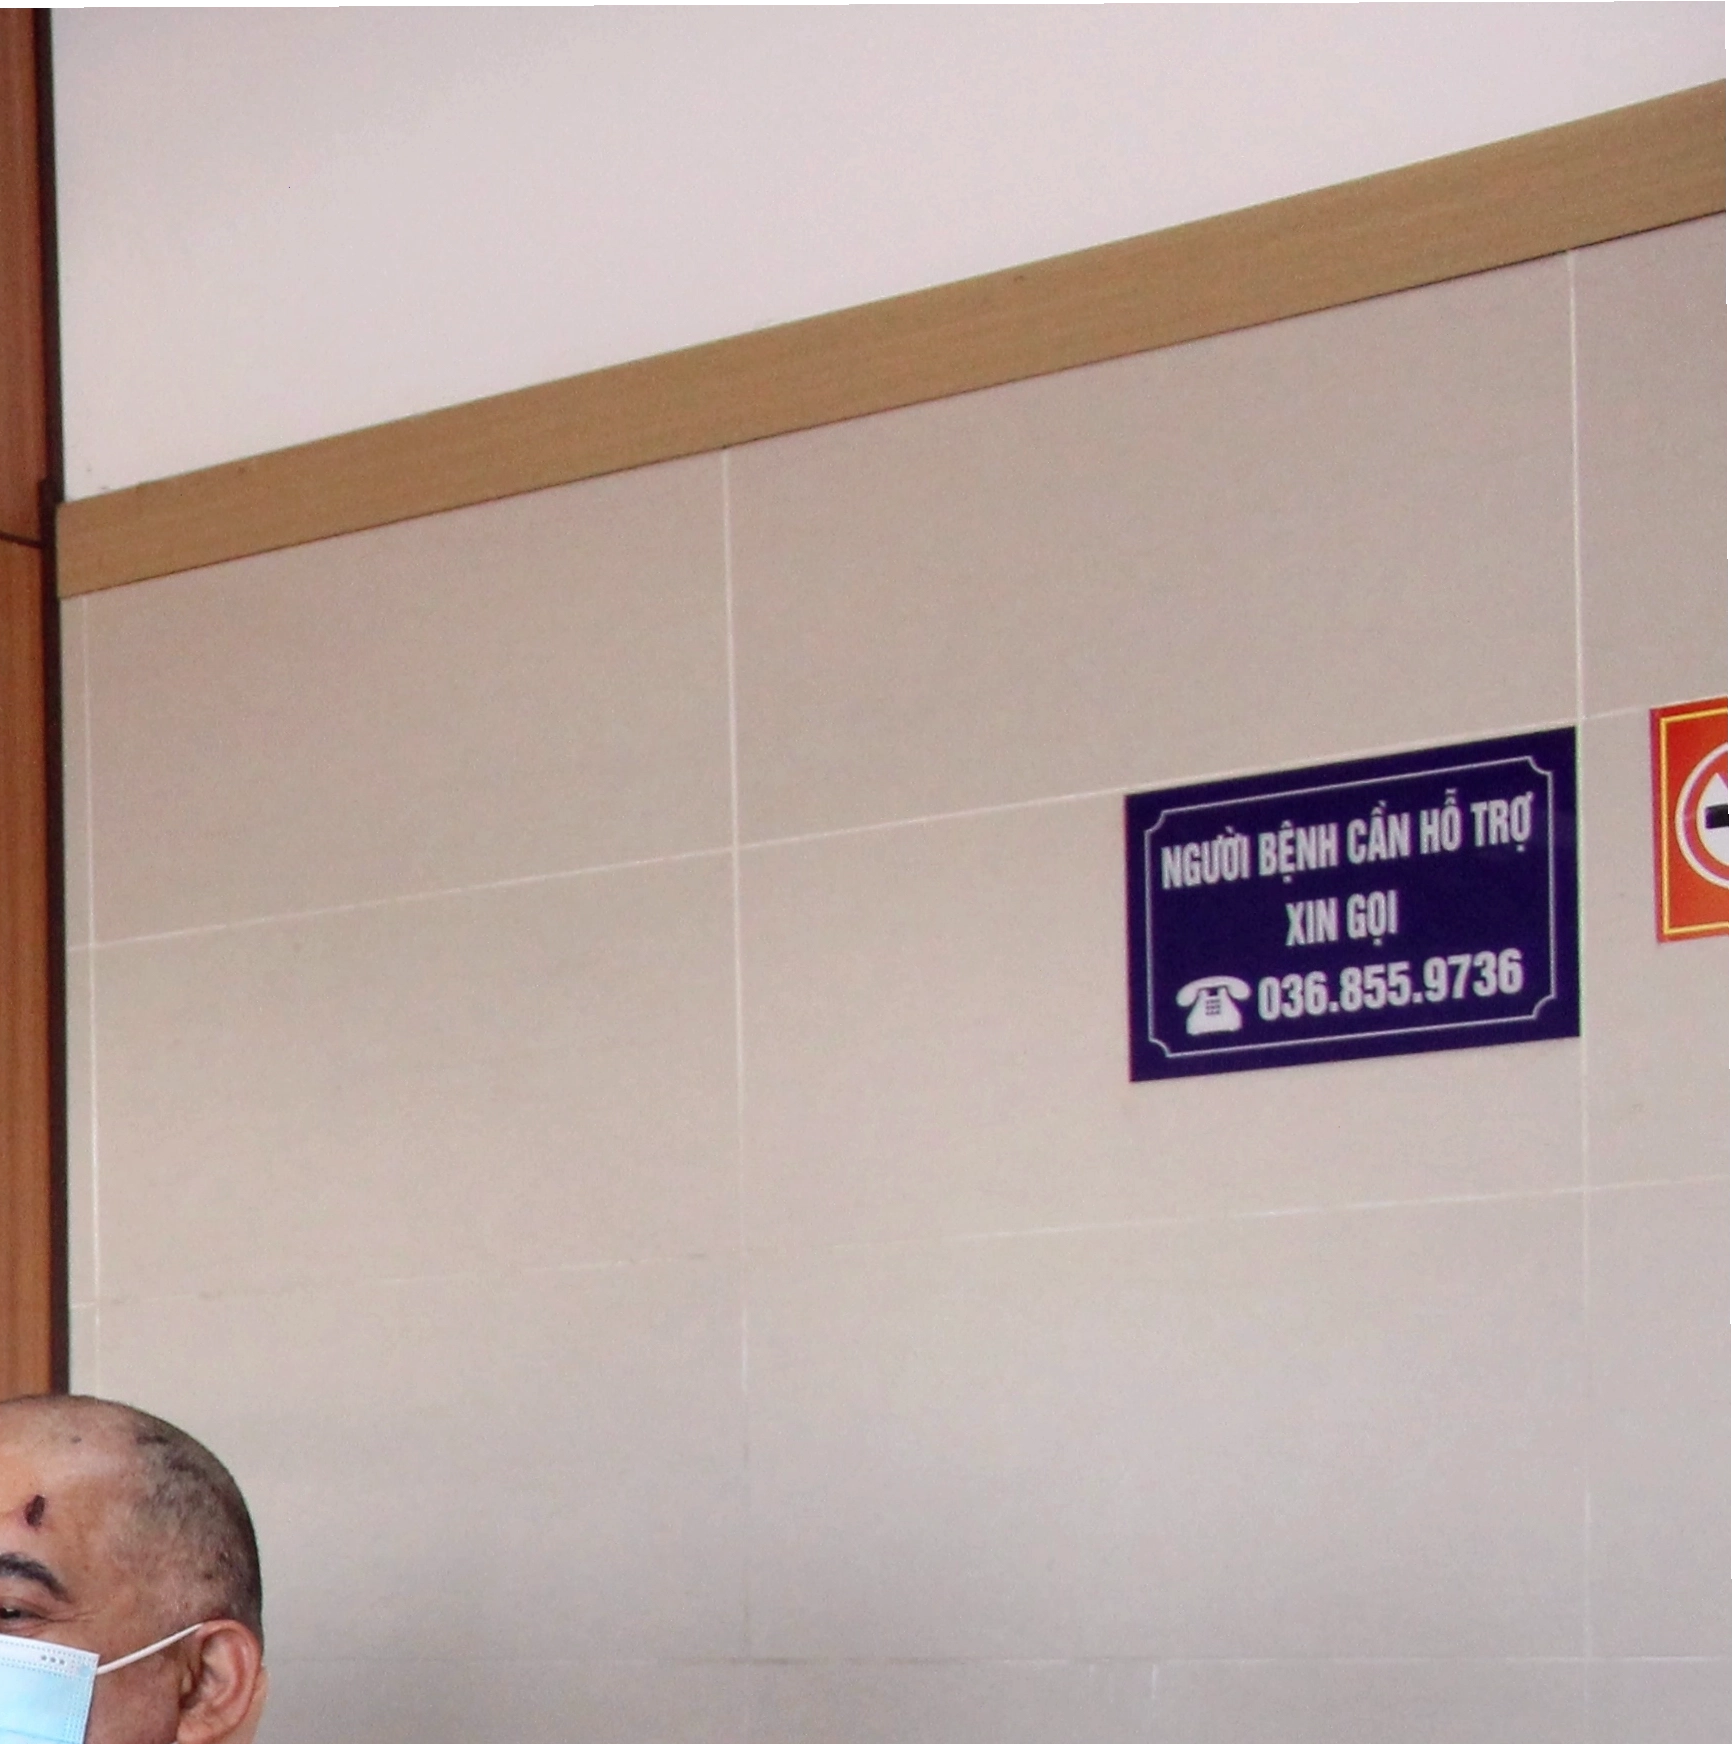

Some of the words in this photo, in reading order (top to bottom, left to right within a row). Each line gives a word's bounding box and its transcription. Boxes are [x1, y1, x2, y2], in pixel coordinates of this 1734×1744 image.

[1161, 825, 1250, 889] NGƯỜI
[1258, 819, 1339, 884] BỆNH
[1346, 800, 1411, 865] CẦN
[1419, 788, 1463, 855] HỖ
[1470, 791, 1534, 852] TRỢ
[1285, 898, 1338, 947] XIN
[1347, 890, 1399, 947] GỌI
[1258, 948, 1524, 1021] 036.855.9736
